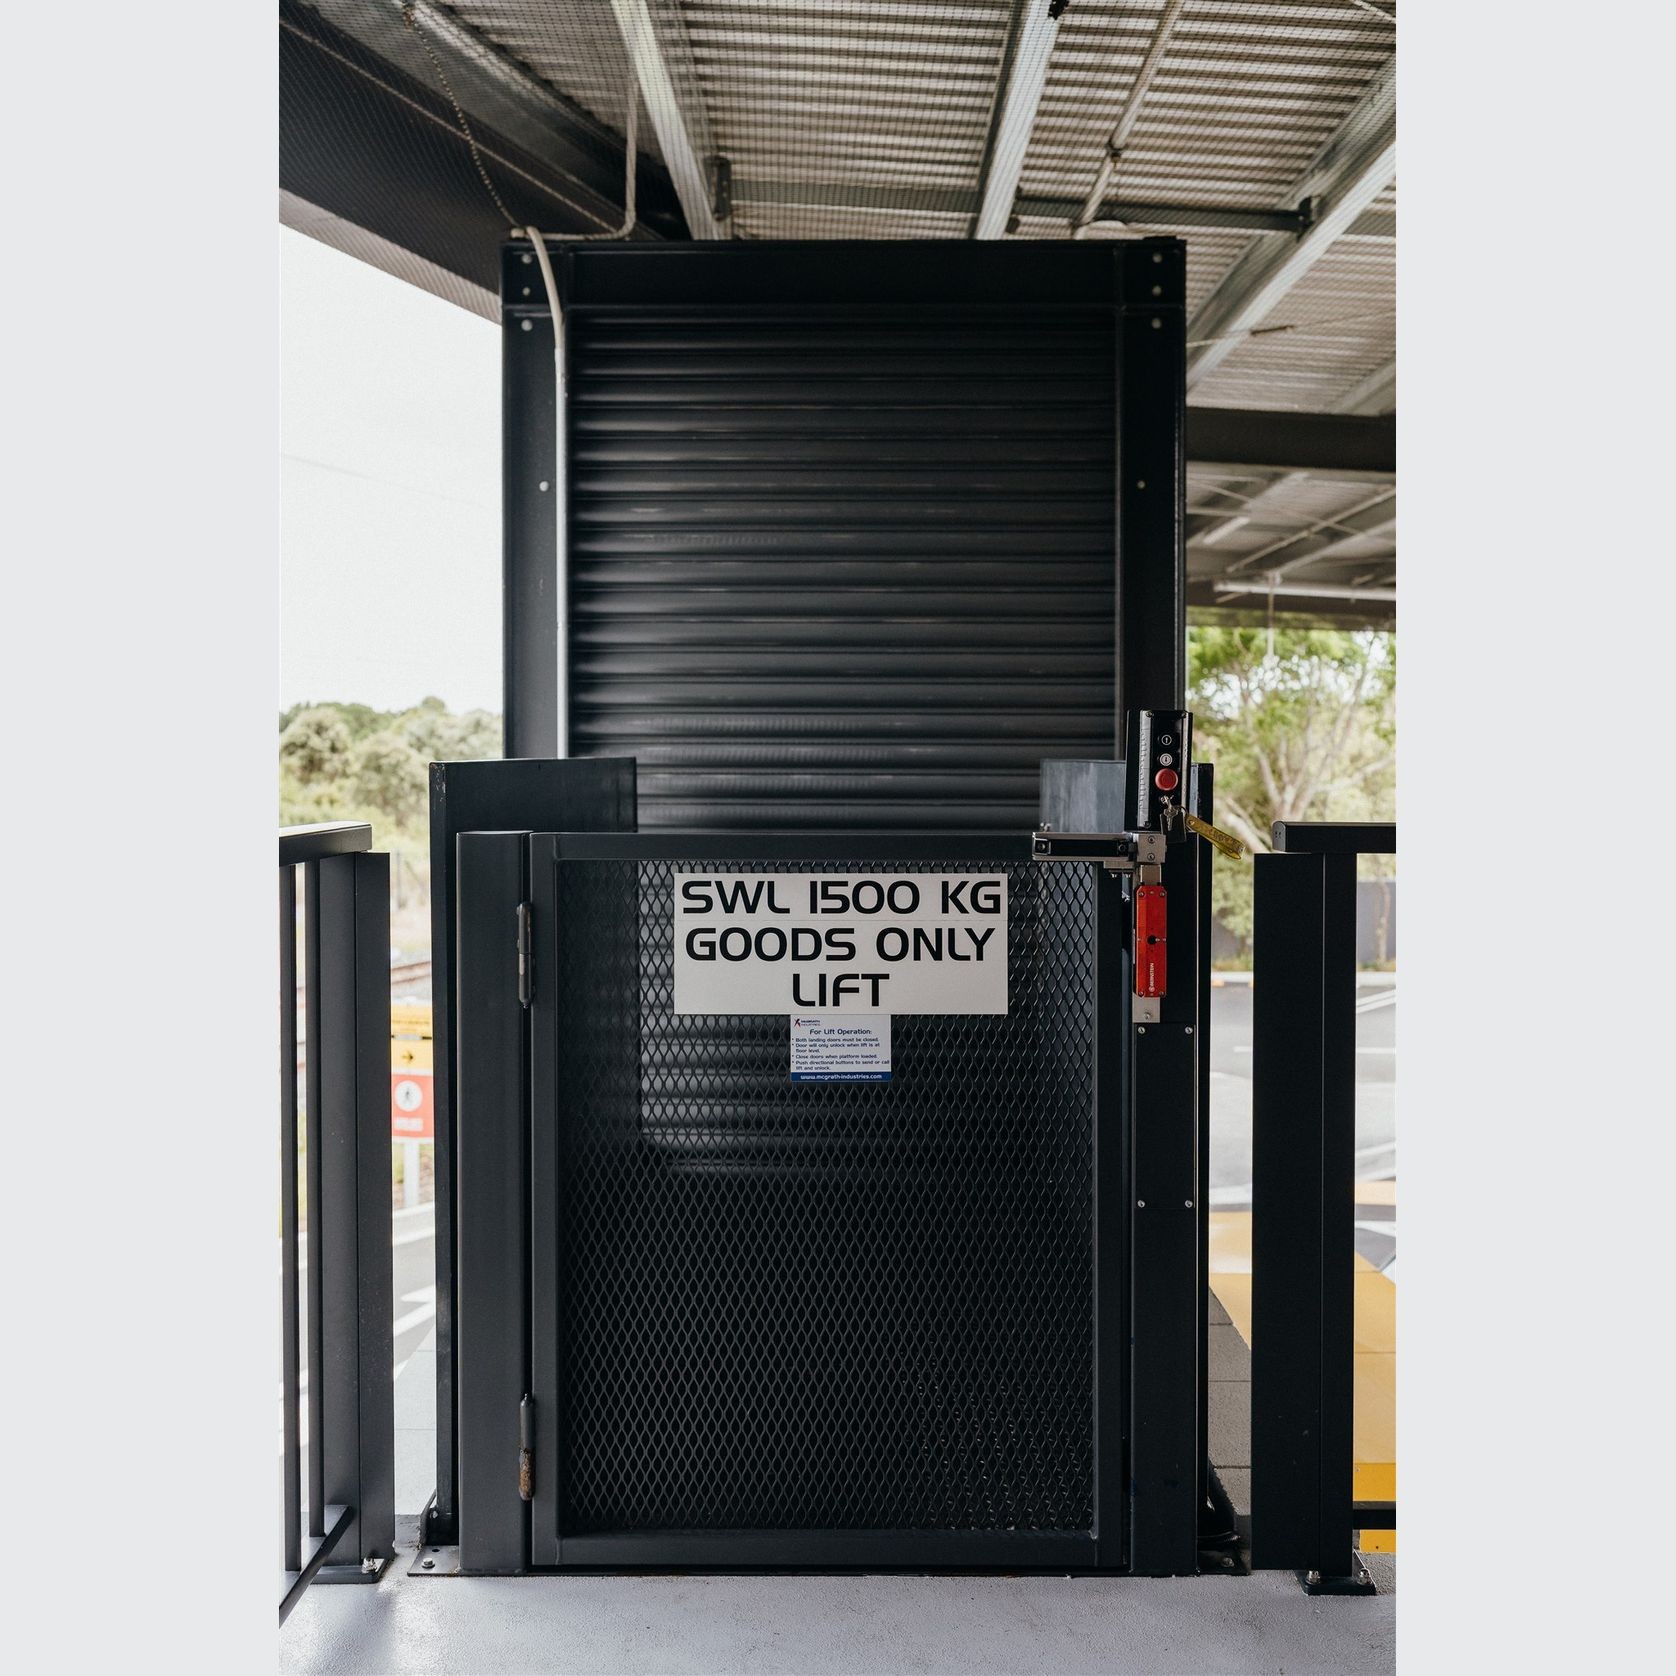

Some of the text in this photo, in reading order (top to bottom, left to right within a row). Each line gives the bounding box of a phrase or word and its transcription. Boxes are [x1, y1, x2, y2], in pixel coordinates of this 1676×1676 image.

[682, 880, 1001, 914] SWL 1500 KG
[686, 927, 996, 961] GOODS ONLY
[792, 973, 890, 1007] LIFT
